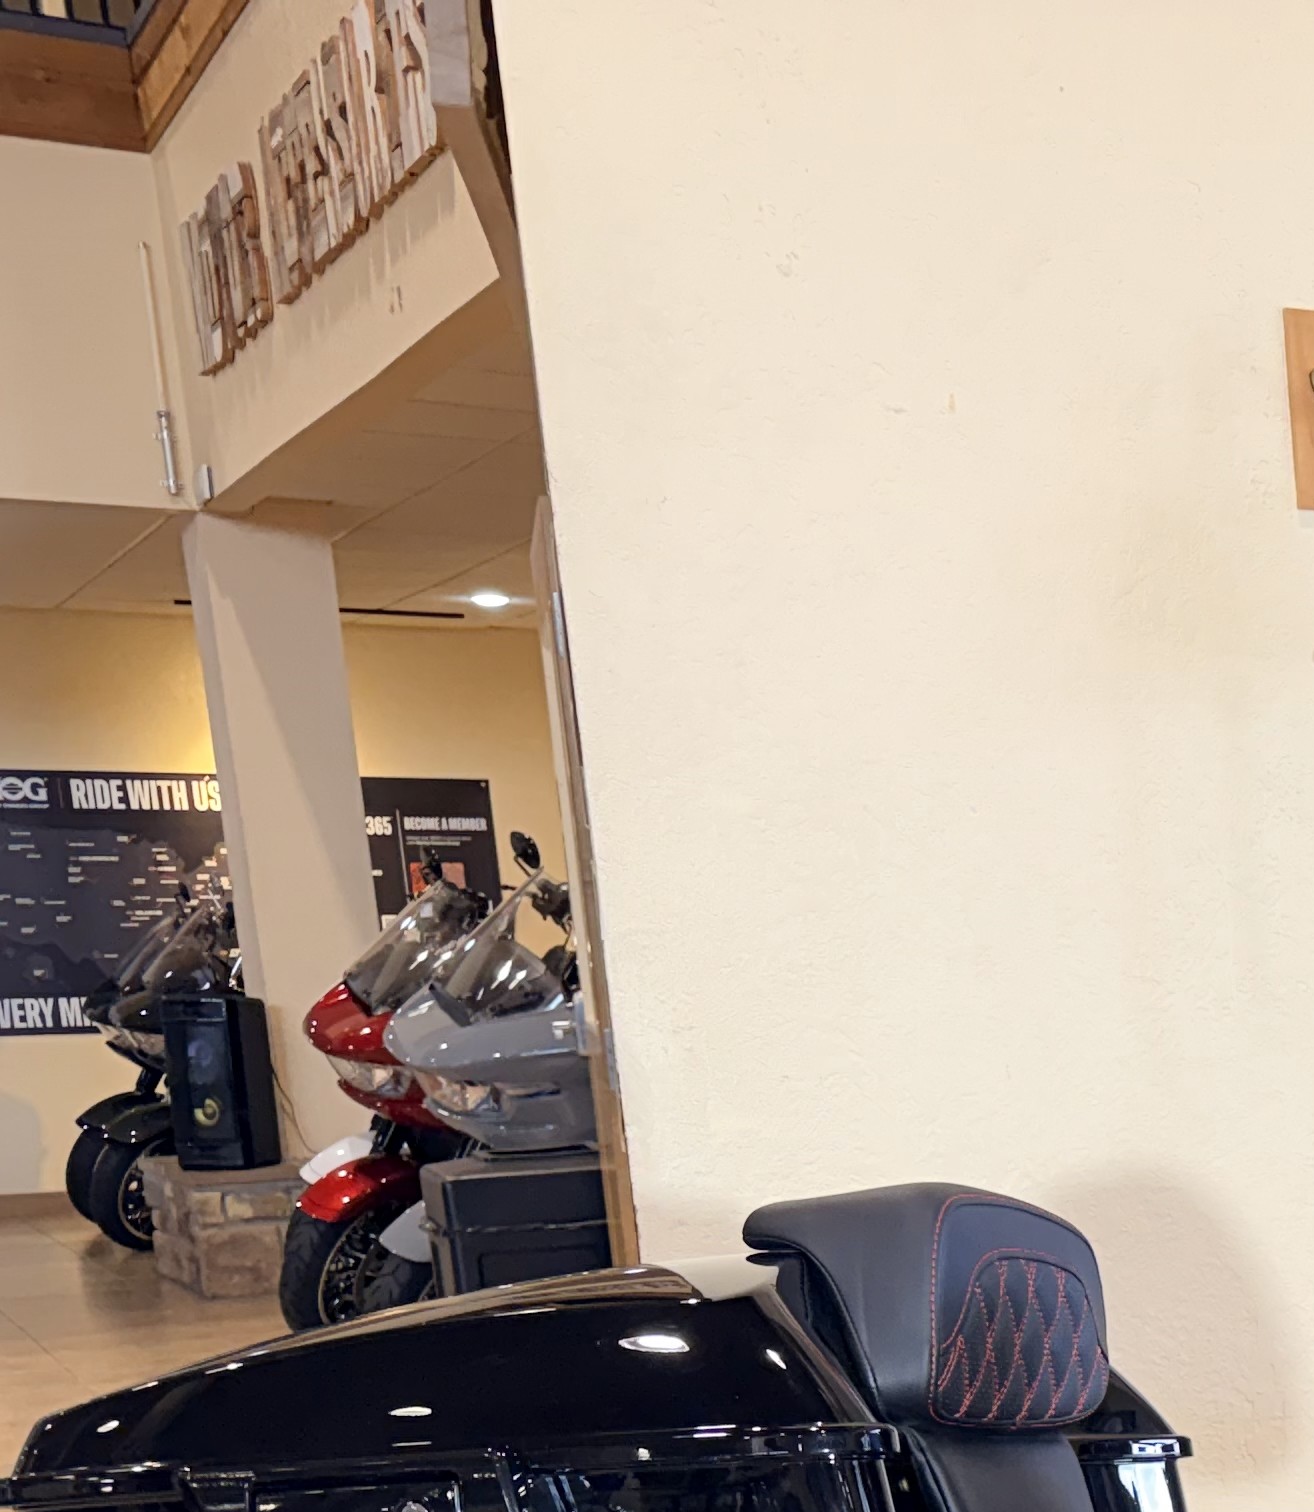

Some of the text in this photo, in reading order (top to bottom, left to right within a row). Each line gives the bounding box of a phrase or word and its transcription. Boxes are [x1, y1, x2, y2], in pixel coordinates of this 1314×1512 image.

[0, 776, 48, 801] OG
[69, 778, 222, 812] RIDE WITH US
[365, 815, 393, 836] 365
